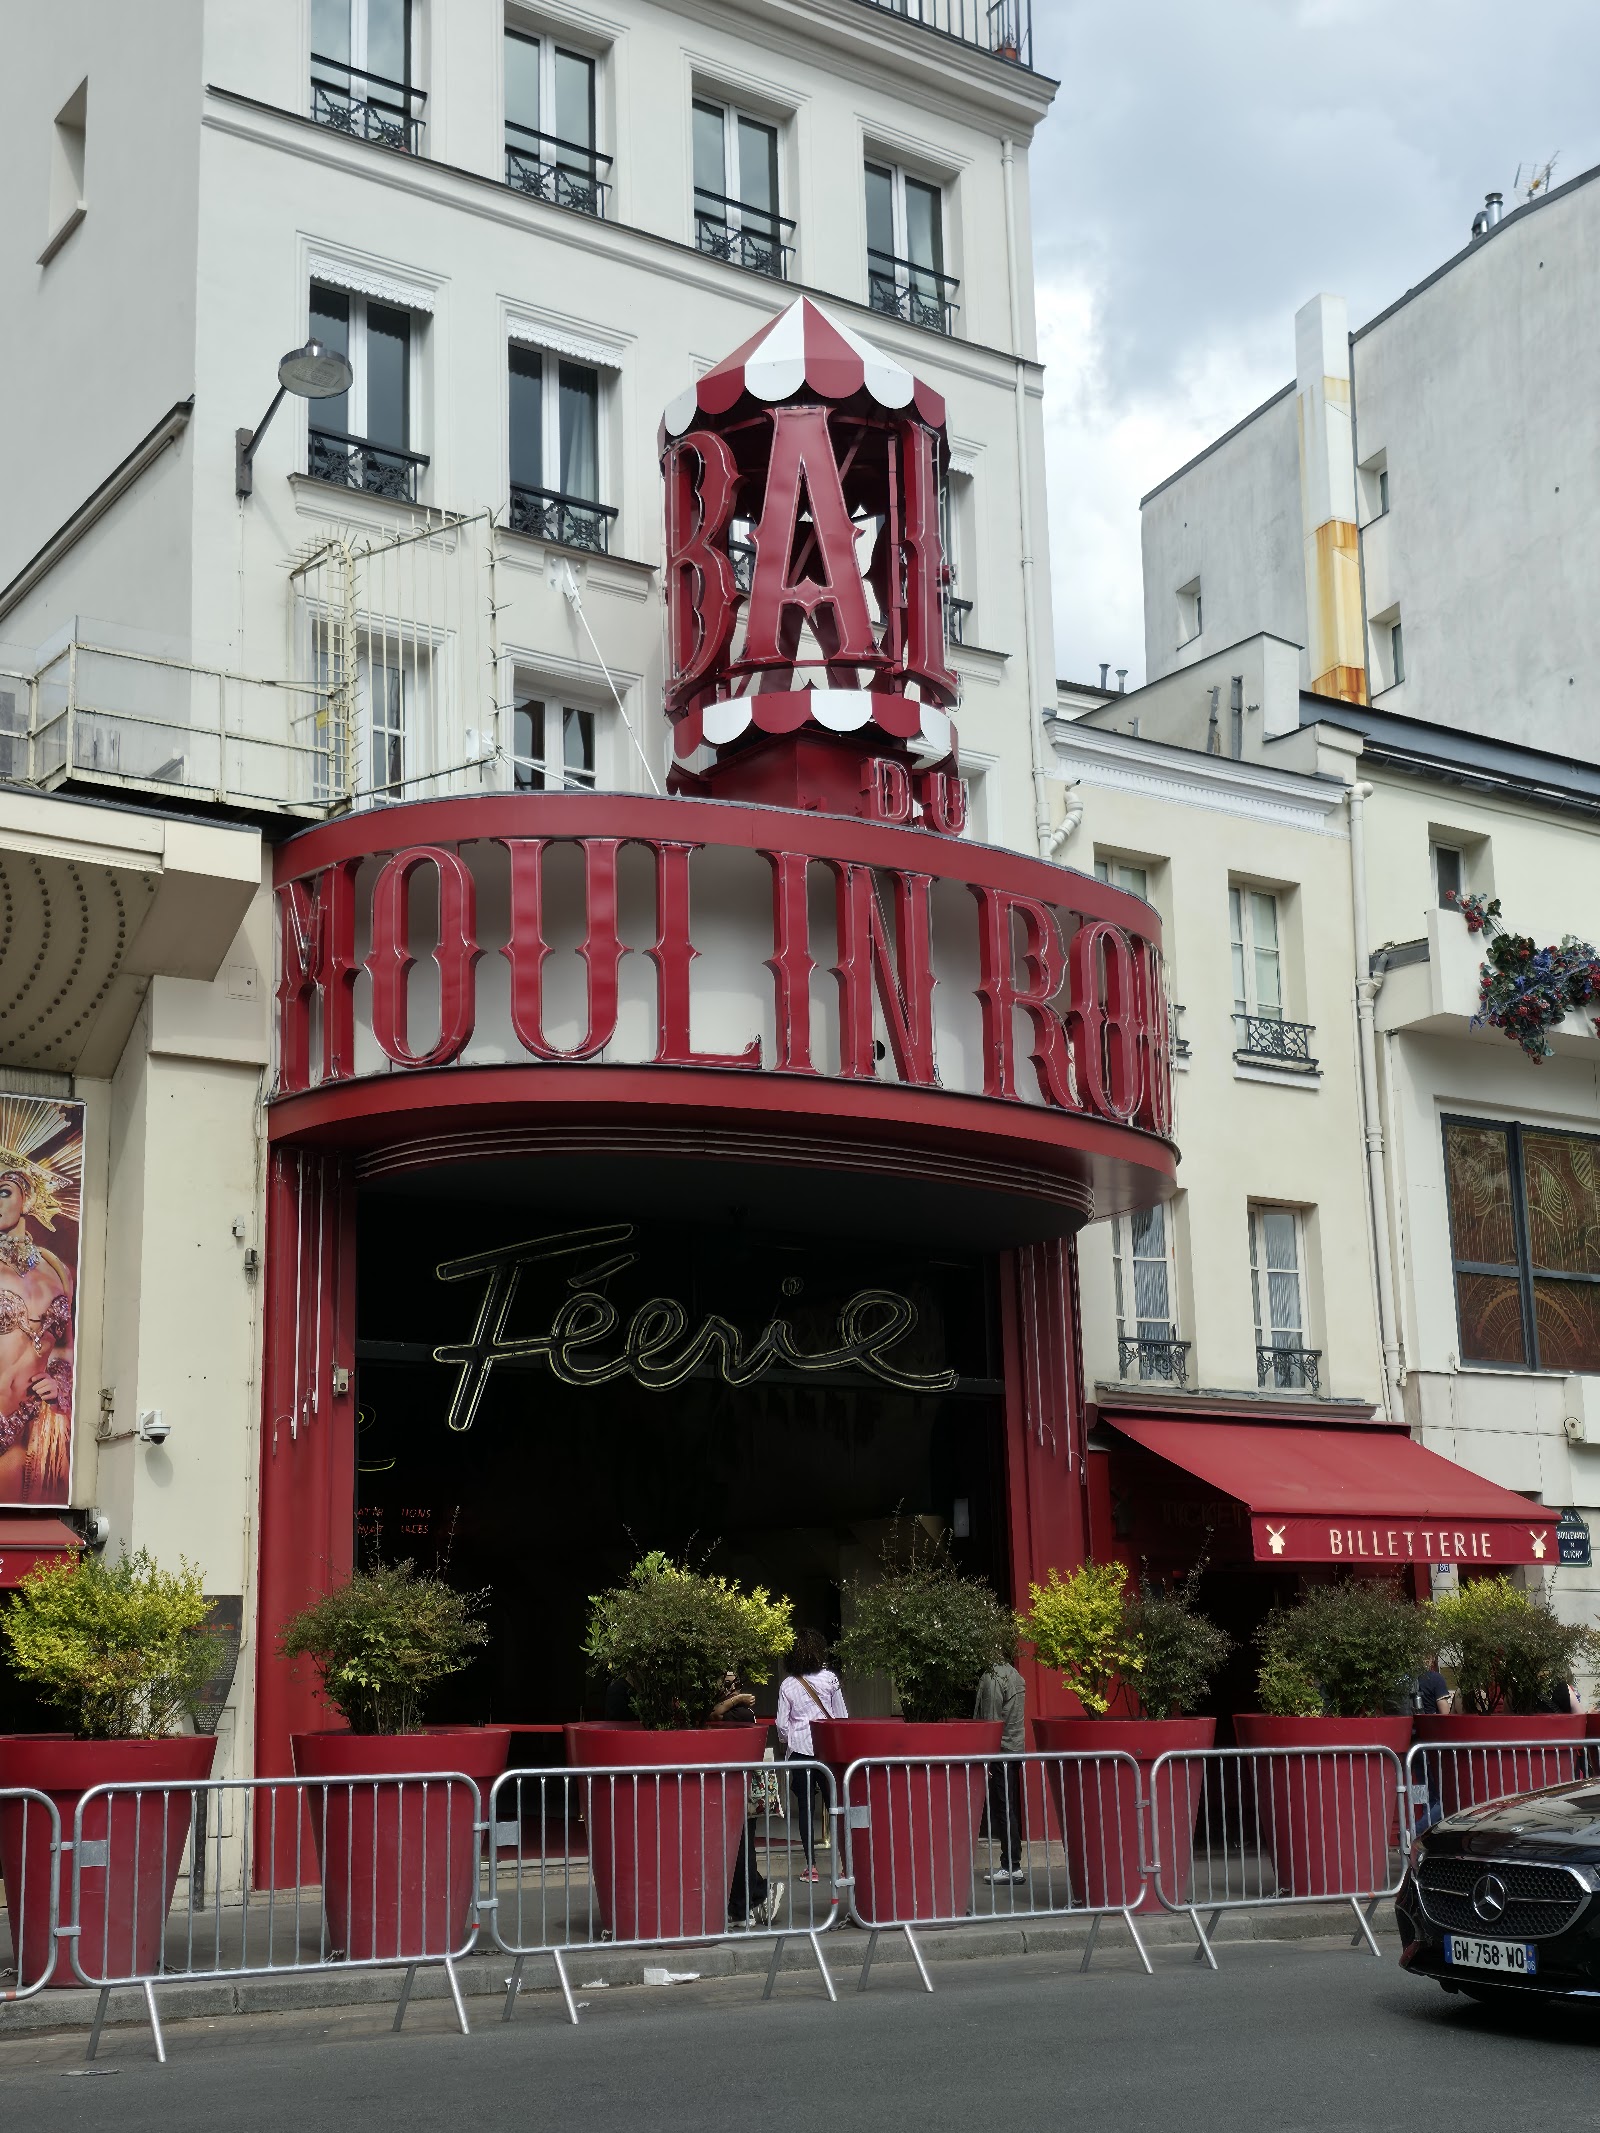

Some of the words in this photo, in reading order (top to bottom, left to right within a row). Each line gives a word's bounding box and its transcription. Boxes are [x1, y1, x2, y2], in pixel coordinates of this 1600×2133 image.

[660, 405, 963, 713] BAL
[859, 757, 970, 837] DU
[274, 836, 942, 1097] MOULIN
[433, 1223, 960, 1431] Féerie
[1329, 1529, 1492, 1558] BILLETTERIE
